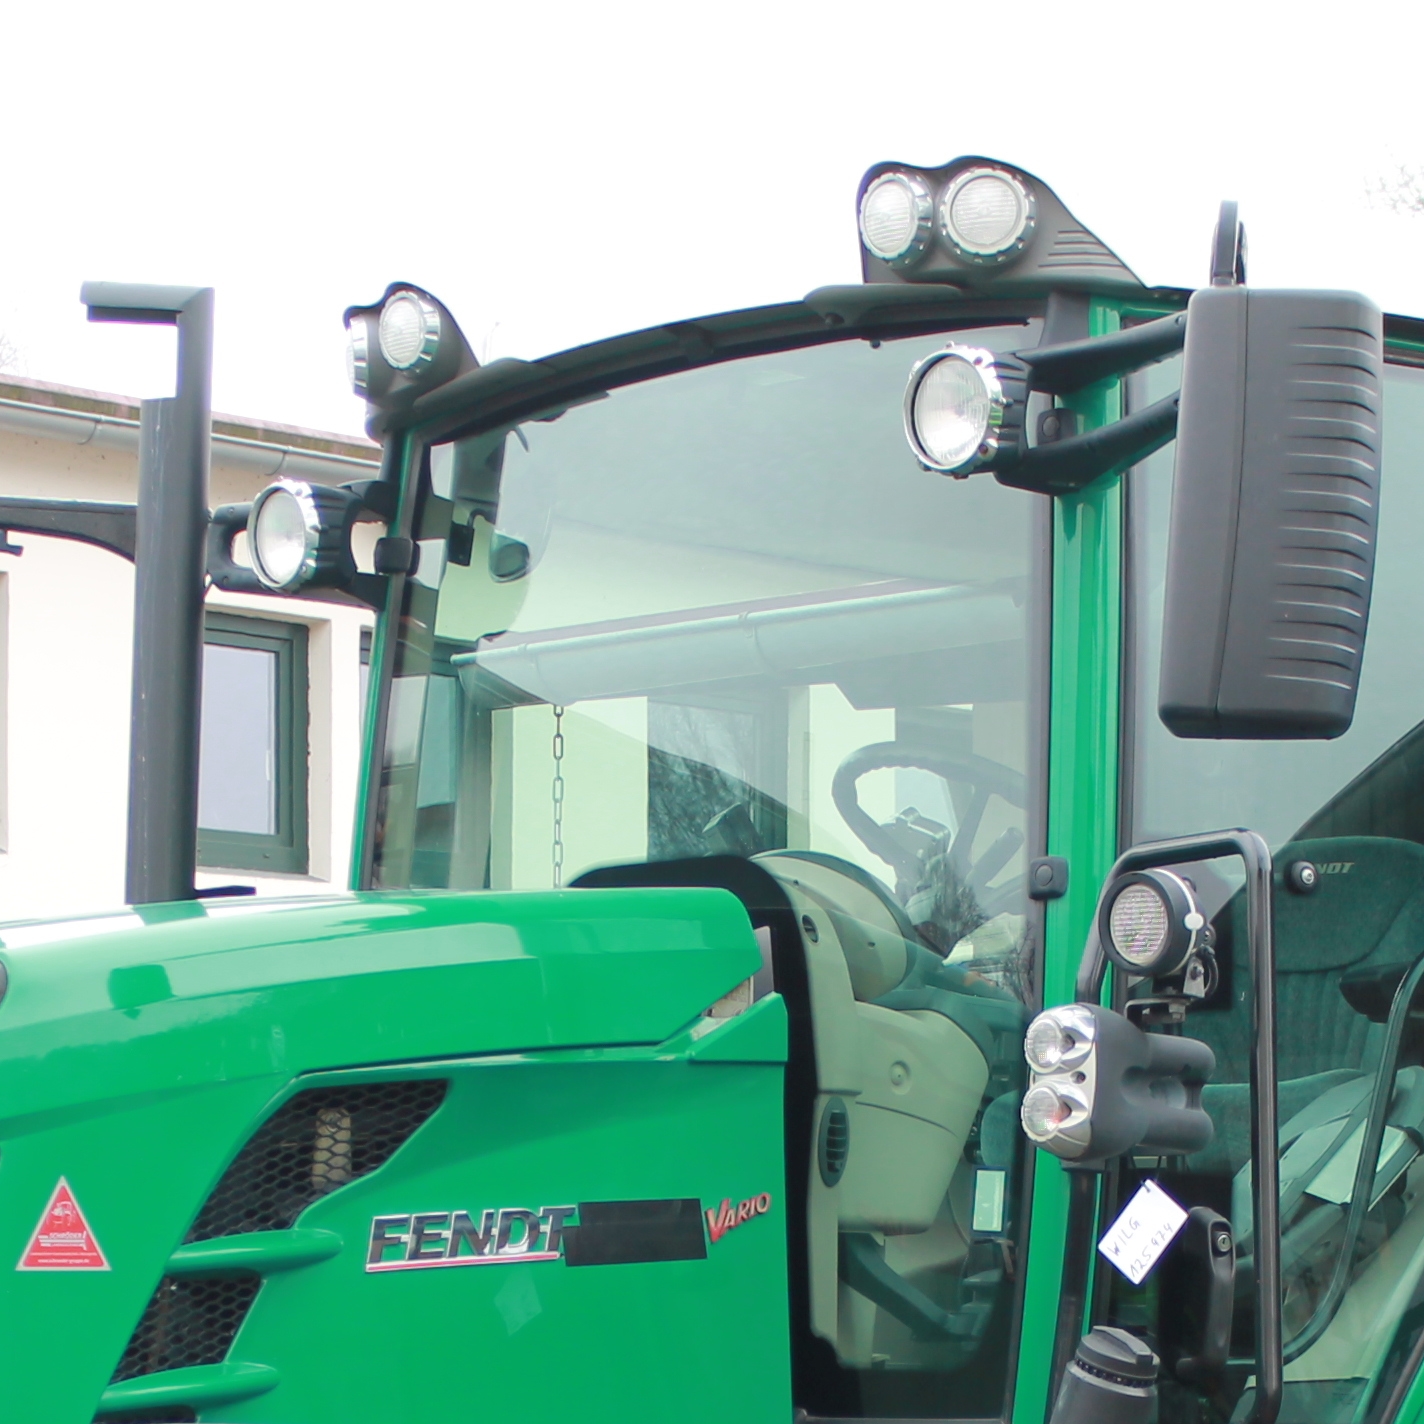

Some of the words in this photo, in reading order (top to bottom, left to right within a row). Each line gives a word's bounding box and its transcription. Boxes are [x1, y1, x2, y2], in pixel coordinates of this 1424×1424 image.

[1314, 861, 1355, 875] NDT
[366, 1205, 577, 1266] FENDT
[705, 1192, 772, 1245] VARIO
[1107, 1216, 1141, 1257] WILG
